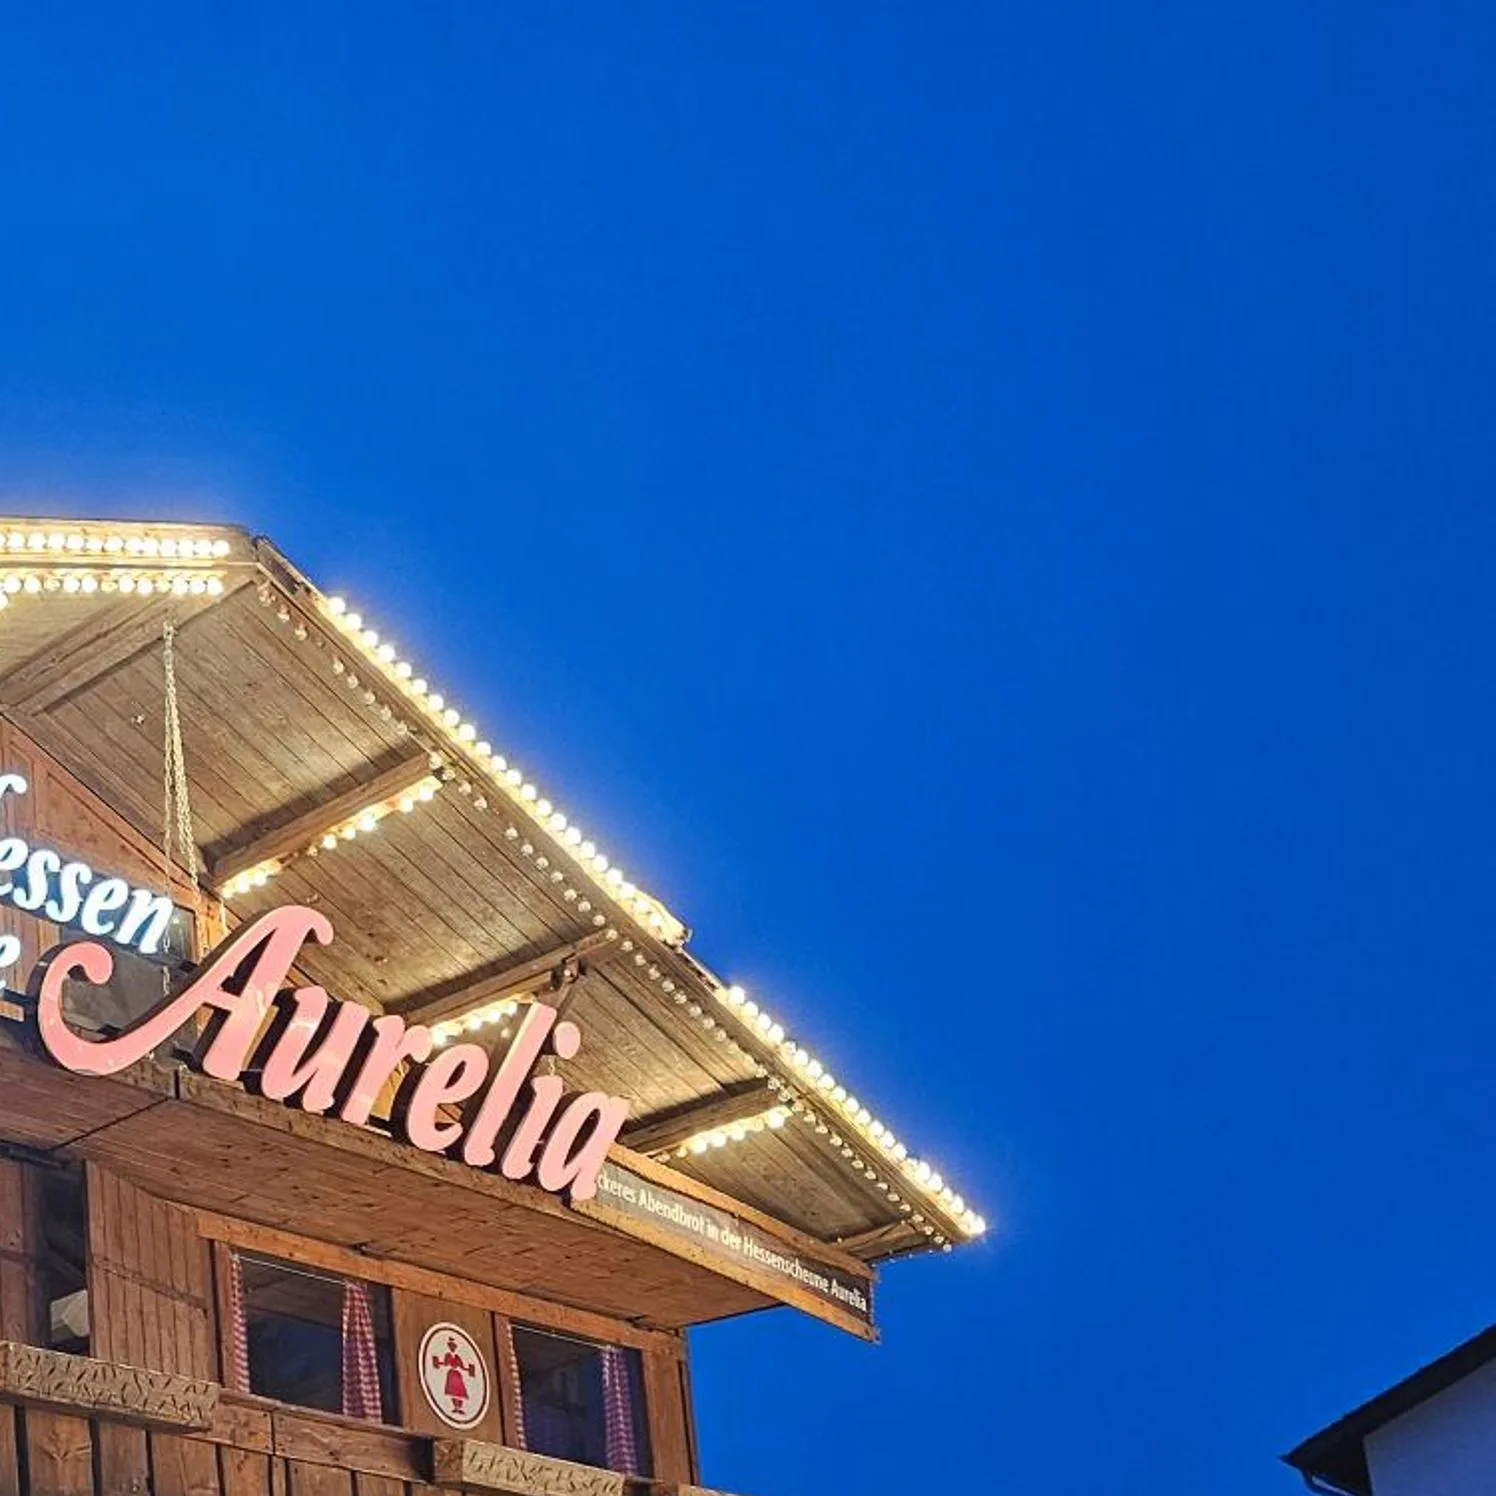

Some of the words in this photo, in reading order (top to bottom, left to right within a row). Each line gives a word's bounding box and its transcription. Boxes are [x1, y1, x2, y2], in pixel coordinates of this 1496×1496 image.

[35, 903, 631, 1200] Aurelia
[597, 1173, 636, 1205] ckeres
[638, 1190, 704, 1231] Abendbrot
[705, 1221, 719, 1242] in
[720, 1227, 742, 1251] der
[743, 1234, 829, 1294] Hessenscheune
